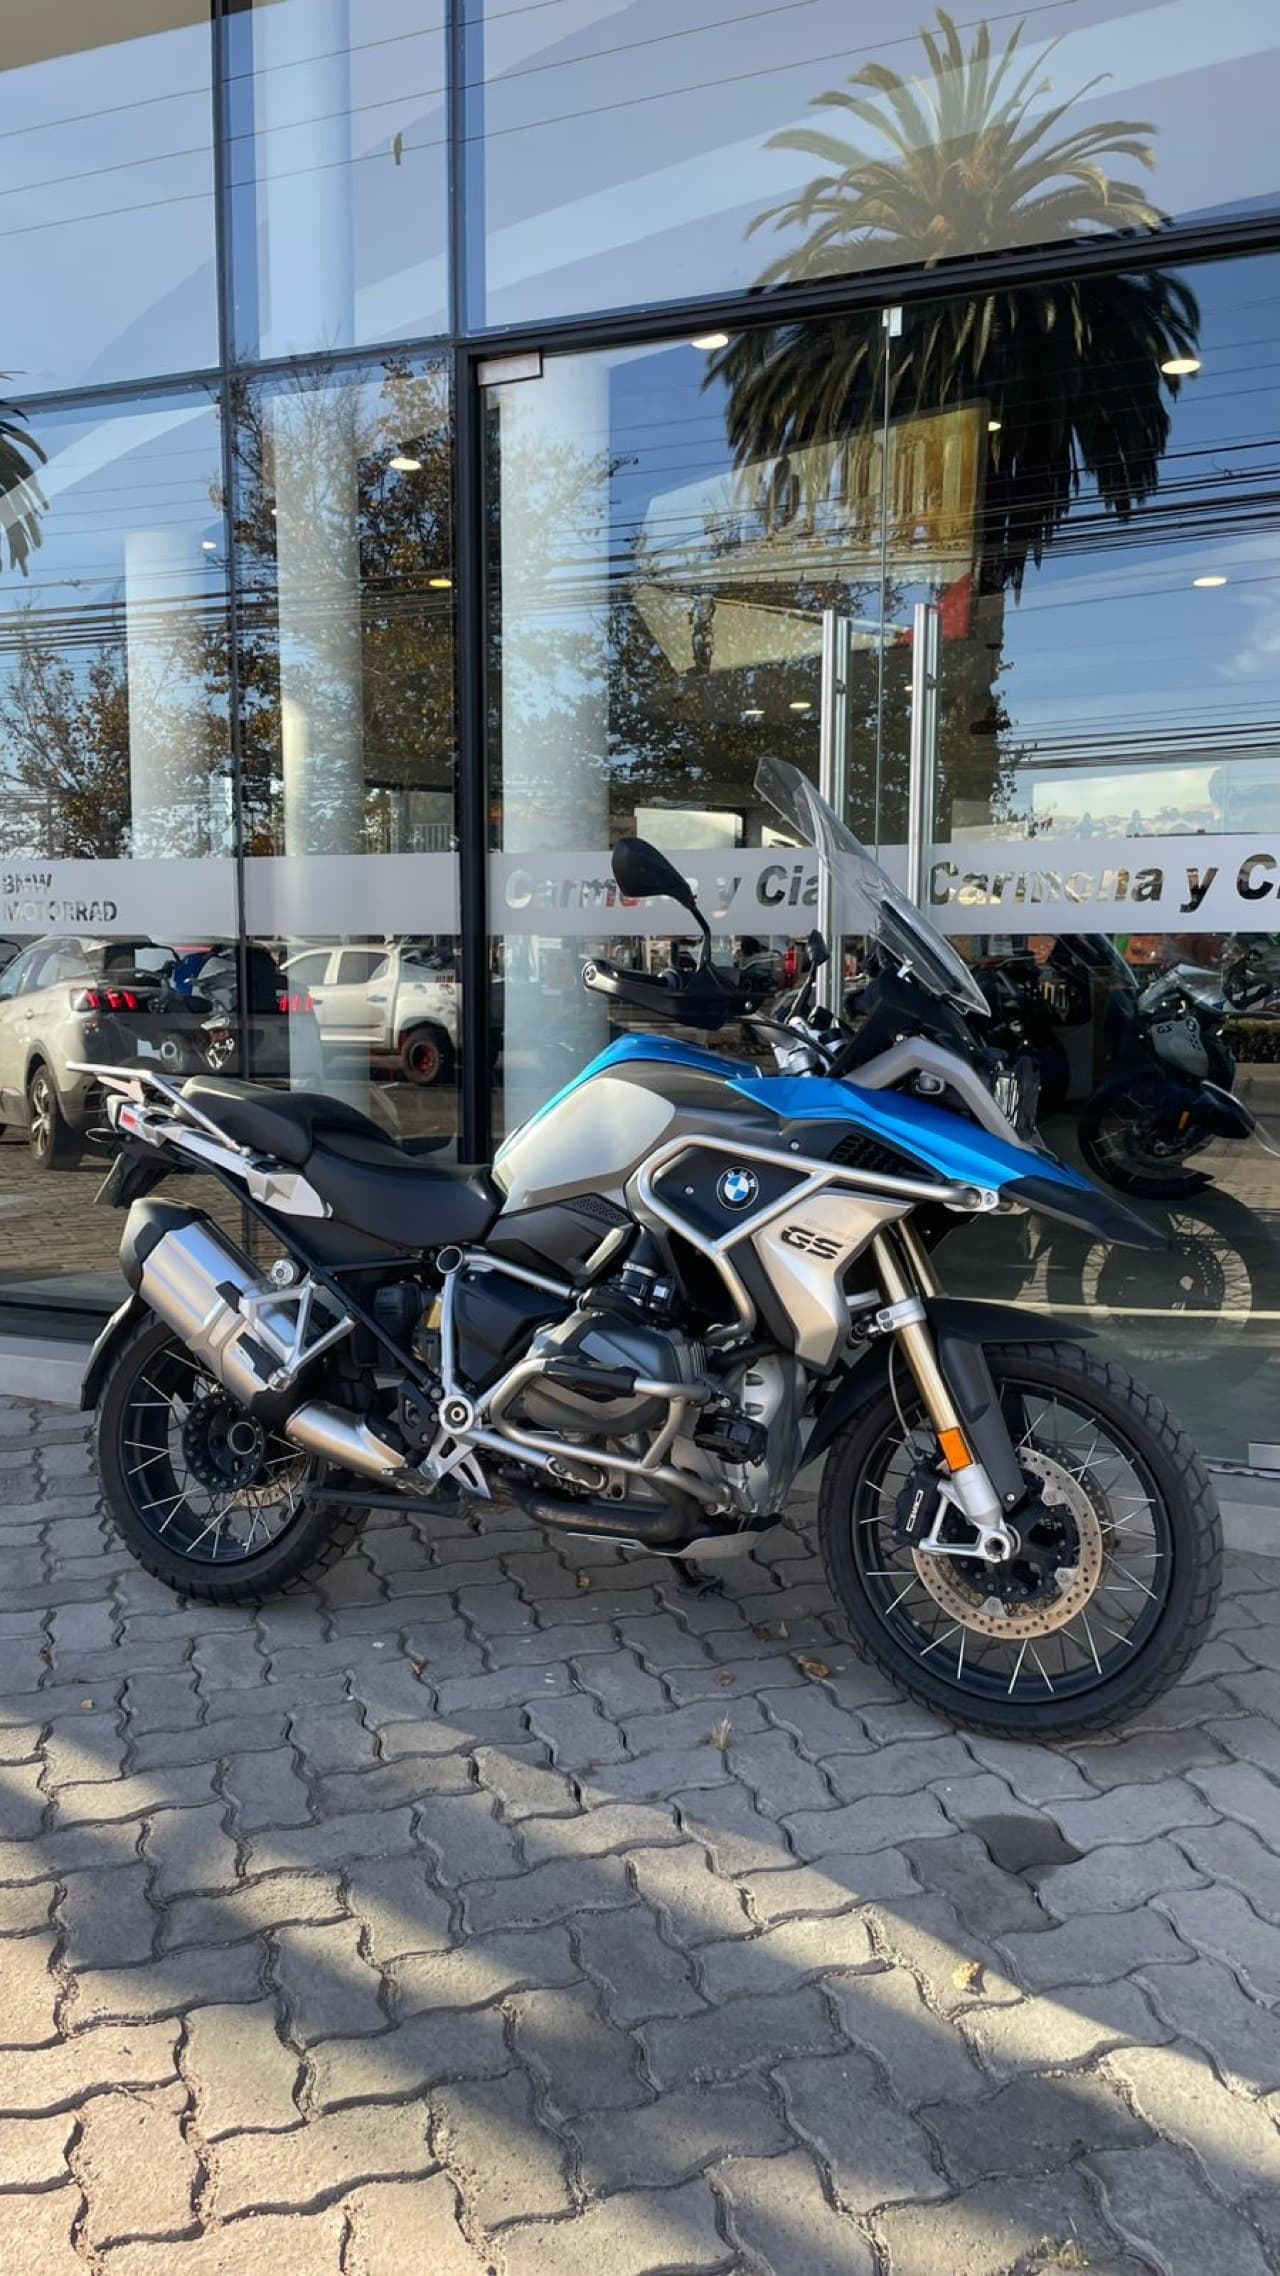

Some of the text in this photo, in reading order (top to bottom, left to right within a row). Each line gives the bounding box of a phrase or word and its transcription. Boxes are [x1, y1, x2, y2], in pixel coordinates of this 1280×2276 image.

[2, 873, 52, 894] BMW
[504, 869, 698, 909] Carm
[711, 876, 742, 918] y
[930, 853, 1280, 913] Carmona y C
[2, 901, 118, 921] MOTORRAD
[780, 1225, 844, 1261] GS
